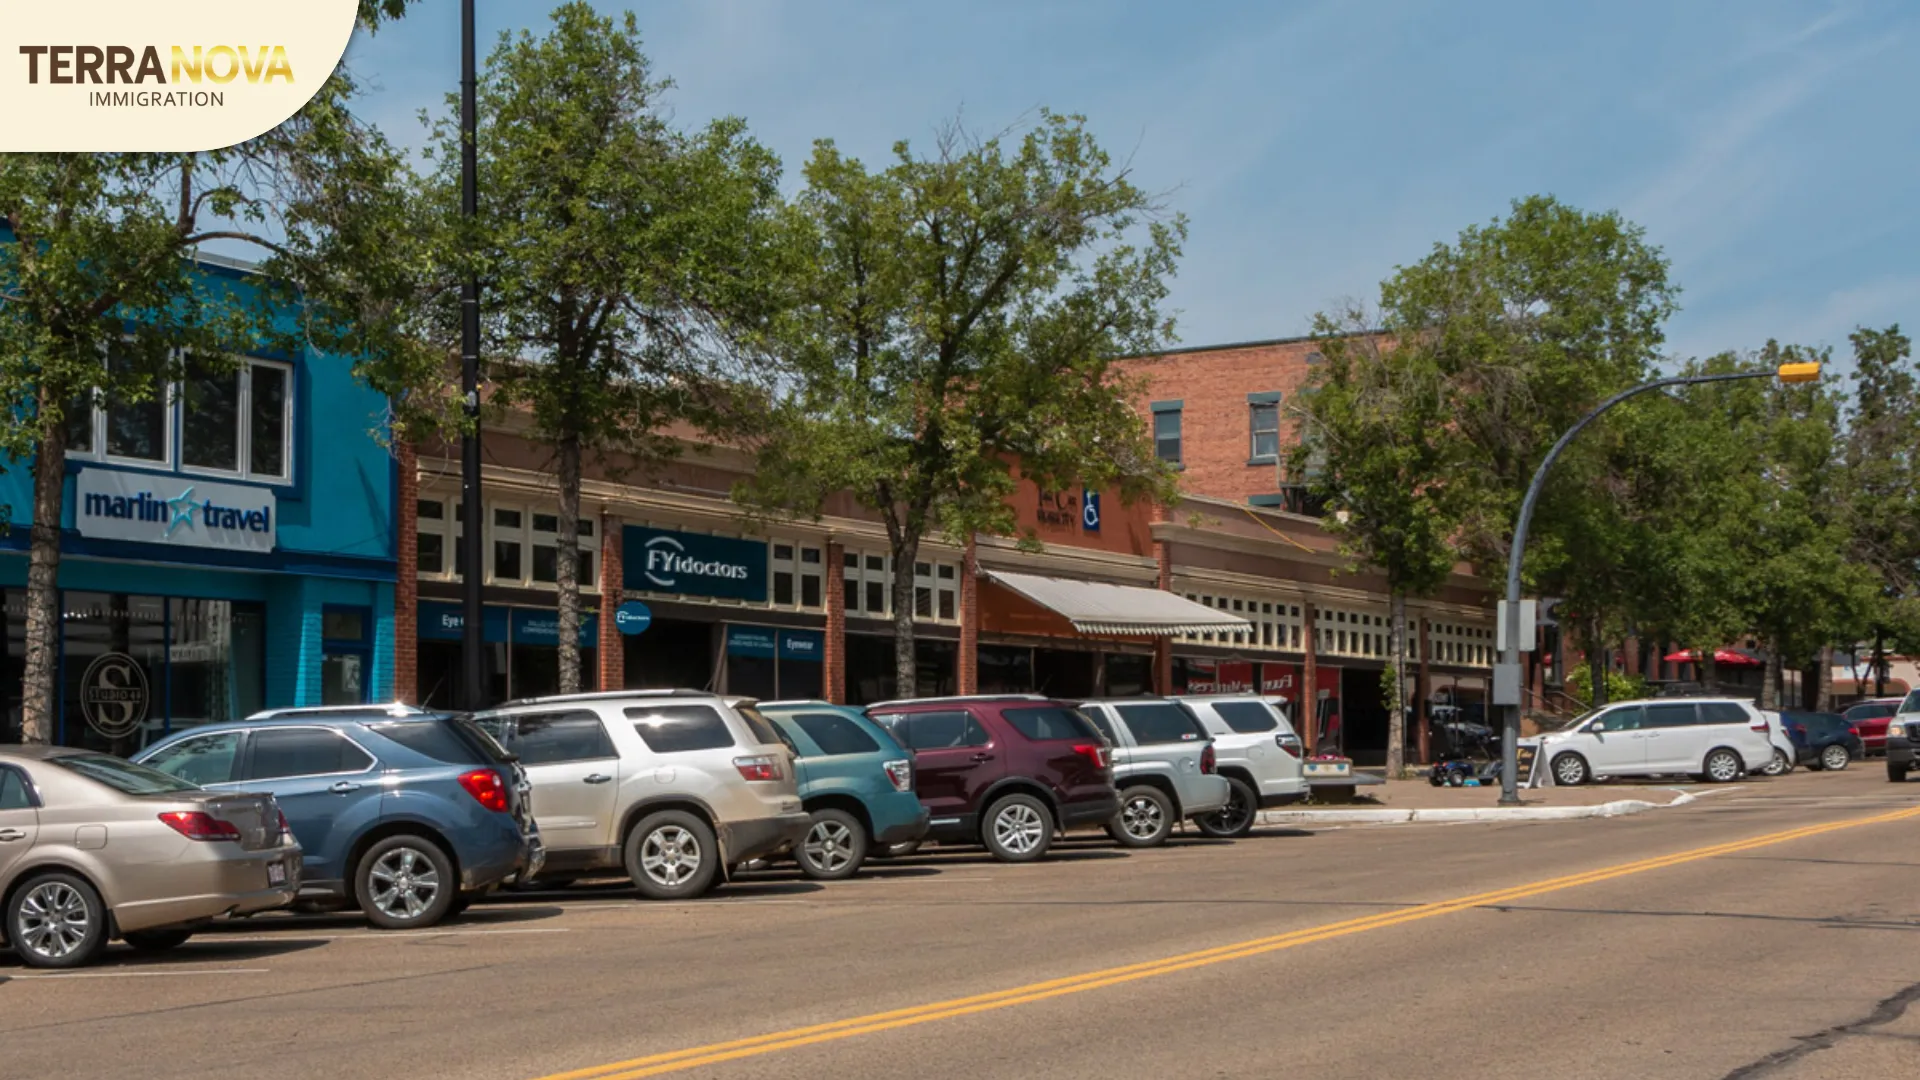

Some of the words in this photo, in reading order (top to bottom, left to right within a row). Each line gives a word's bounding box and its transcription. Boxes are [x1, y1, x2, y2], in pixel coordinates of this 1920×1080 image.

[85, 492, 169, 523] marlin
[203, 500, 270, 533] travel
[647, 549, 748, 579] FYidoctors
[442, 614, 459, 628] Eye
